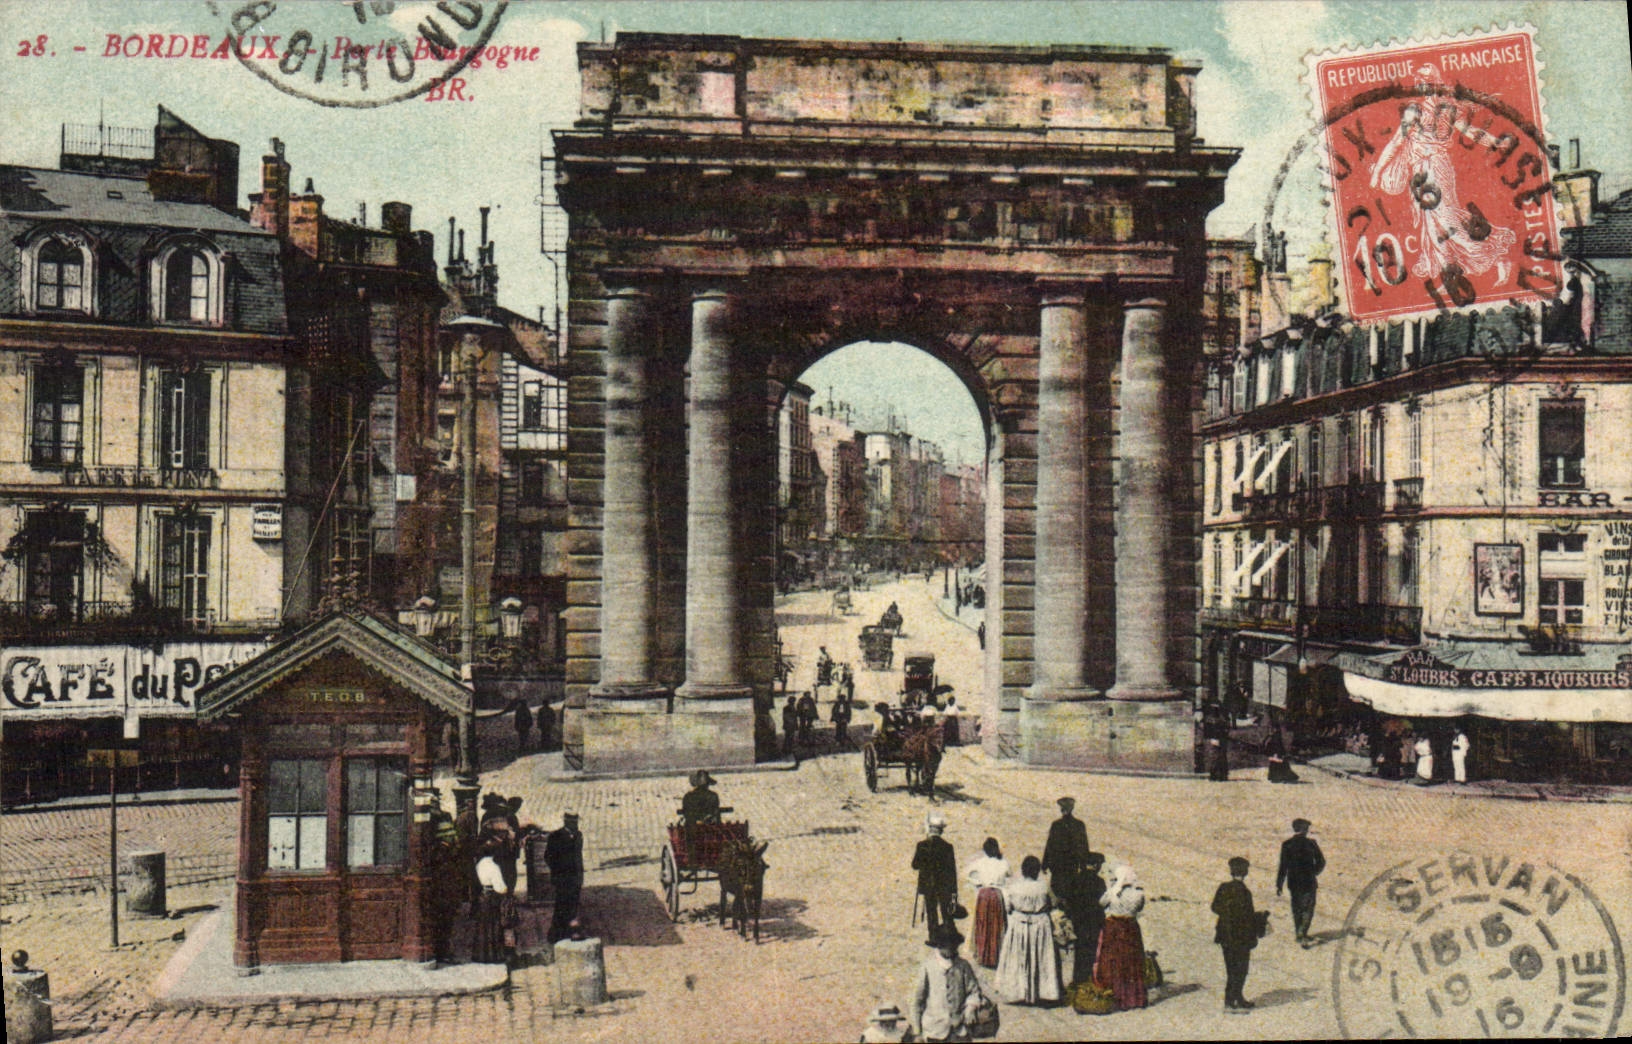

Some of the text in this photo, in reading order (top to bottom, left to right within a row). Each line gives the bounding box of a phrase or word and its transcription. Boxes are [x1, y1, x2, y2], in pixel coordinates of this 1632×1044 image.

[1440, 44, 1523, 73] FRANÇAISE
[1537, 492, 1614, 508] BAR
[1407, 651, 1434, 667] BAR
[2, 656, 115, 709] CAFÉ
[132, 664, 168, 699] du
[1530, 670, 1630, 688] LIQUEURS
[1386, 855, 1571, 917] SERVAN
